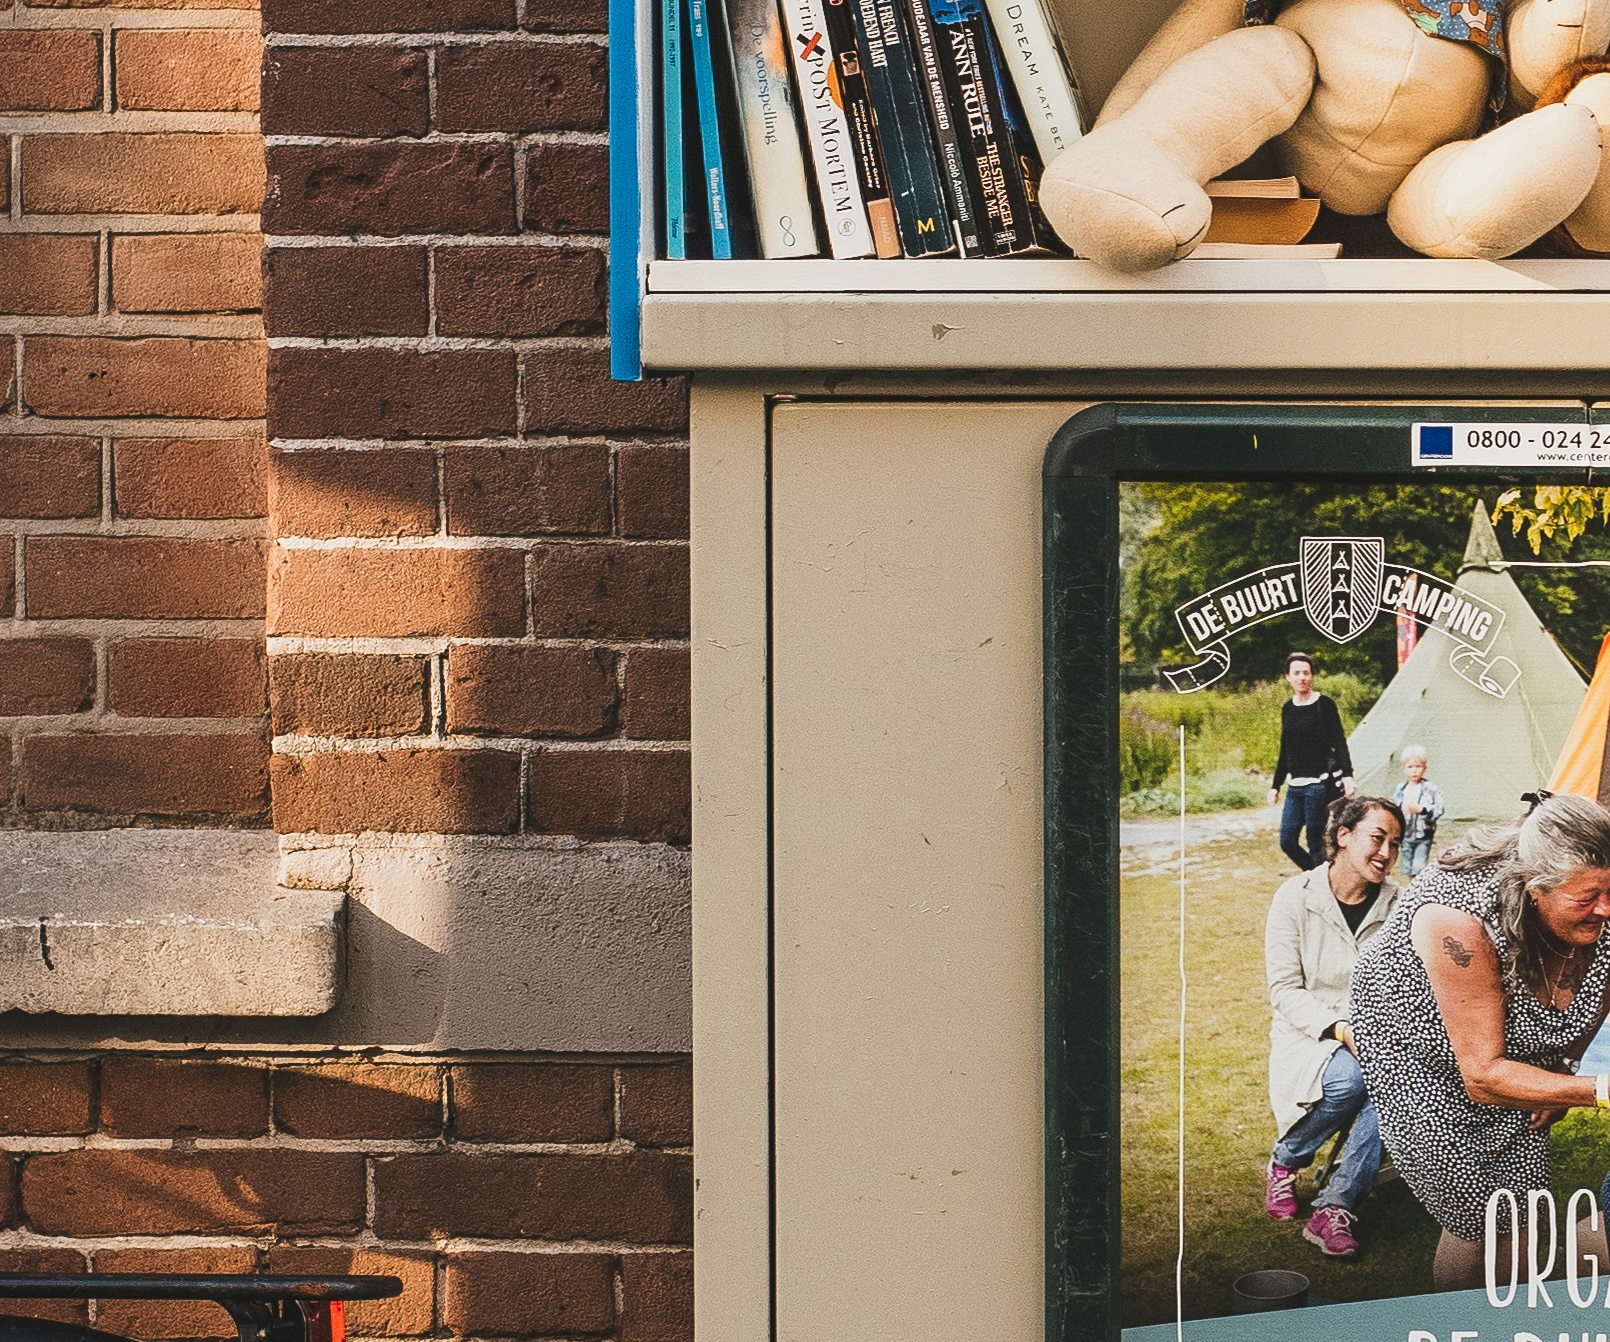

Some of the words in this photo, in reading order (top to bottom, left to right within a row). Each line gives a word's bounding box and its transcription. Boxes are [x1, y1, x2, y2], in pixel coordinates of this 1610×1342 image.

[879, 1, 900, 46] FRENCH
[868, 40, 887, 67] HART
[922, 44, 937, 65] VAN
[927, 65, 939, 80] DE
[756, 51, 778, 146] voorspelling
[950, 30, 972, 76] ANN
[961, 83, 986, 139] RULE
[1007, 4, 1039, 77] DREAM
[1036, 86, 1054, 121] KATE
[1051, 126, 1065, 152] BET
[931, 80, 951, 131] MENSHEID
[987, 141, 1000, 165] THE
[953, 179, 971, 222] Ammaniti
[976, 156, 996, 198] BESIDE
[986, 200, 1000, 219] ME
[991, 167, 1013, 227] STRANGER
[917, 217, 935, 236] M
[1467, 430, 1521, 449] 0800
[1543, 431, 1582, 449] 024
[1186, 605, 1226, 642] DE
[1220, 573, 1299, 624] BUURT
[1383, 575, 1494, 642] CAMPING
